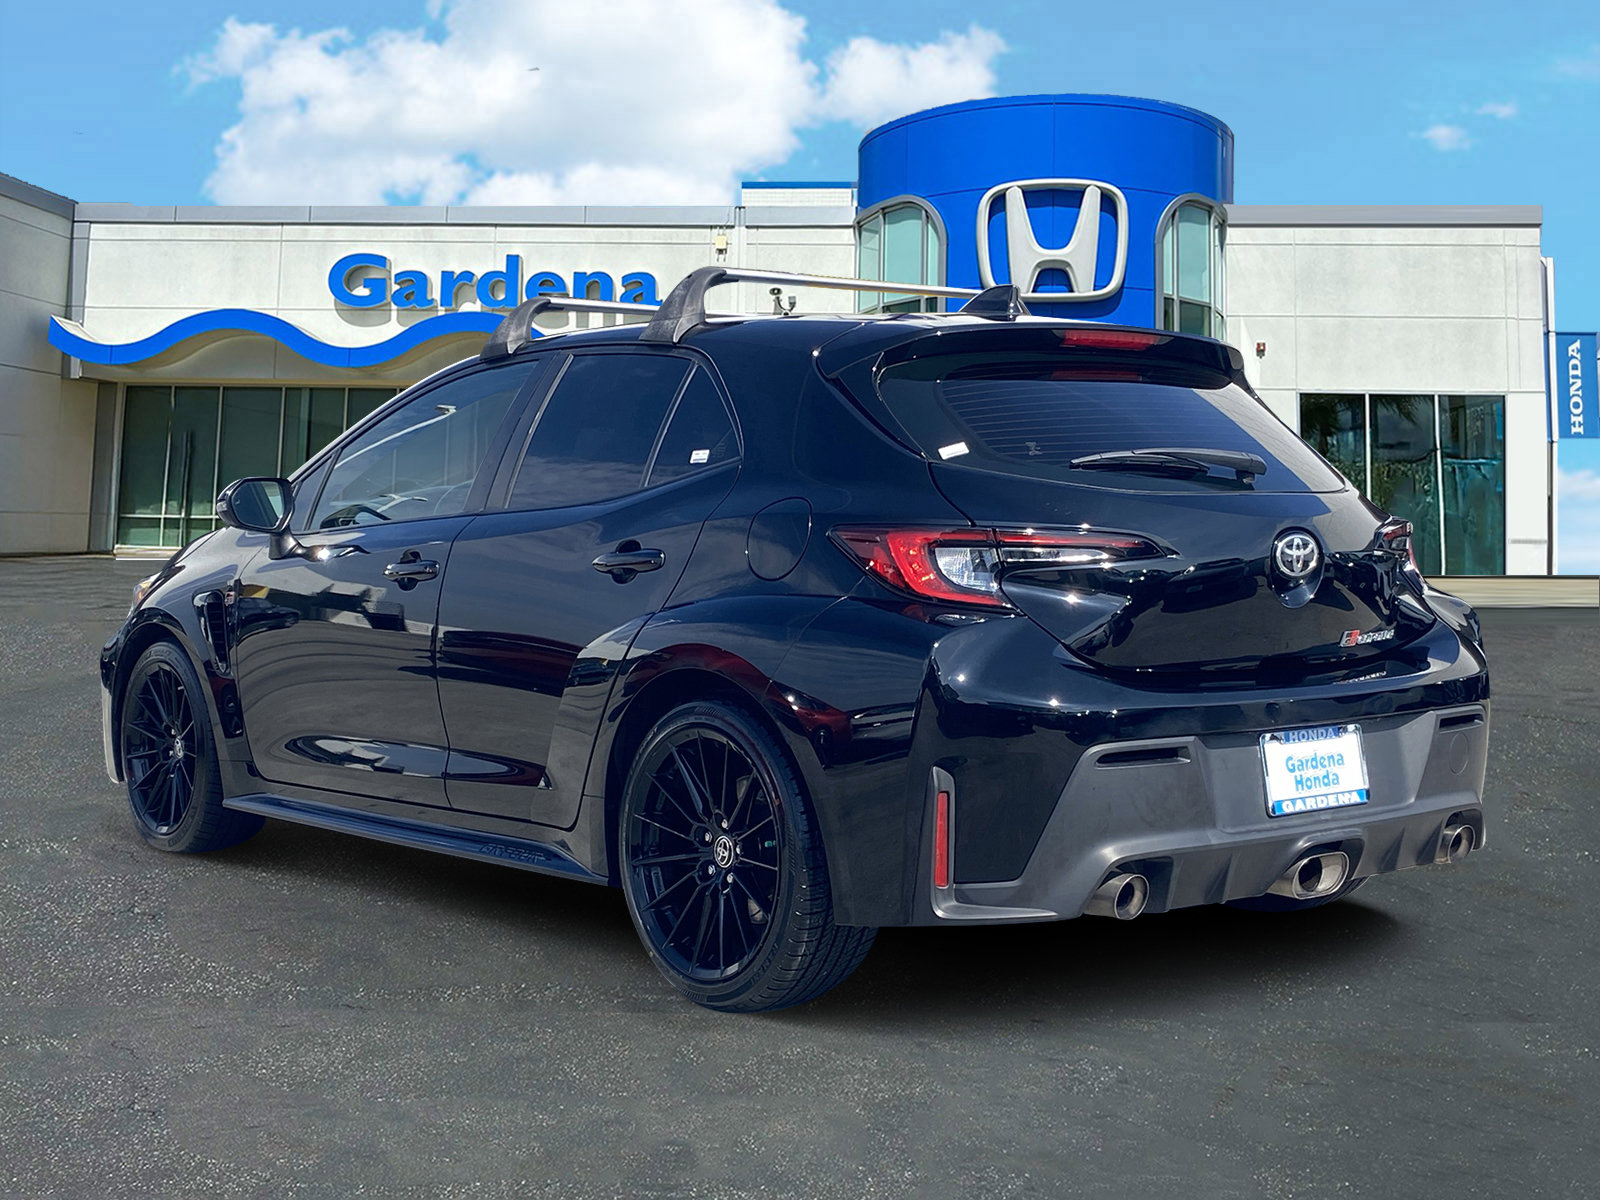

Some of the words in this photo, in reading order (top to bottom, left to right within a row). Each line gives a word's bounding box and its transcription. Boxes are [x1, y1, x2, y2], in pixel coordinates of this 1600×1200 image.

[328, 252, 663, 309] Gardena
[1568, 339, 1584, 435] HONDA
[1288, 727, 1335, 744] HONDA
[1285, 752, 1344, 774] Gardena
[1294, 769, 1340, 792] Honda
[1281, 791, 1361, 813] GARDENA
